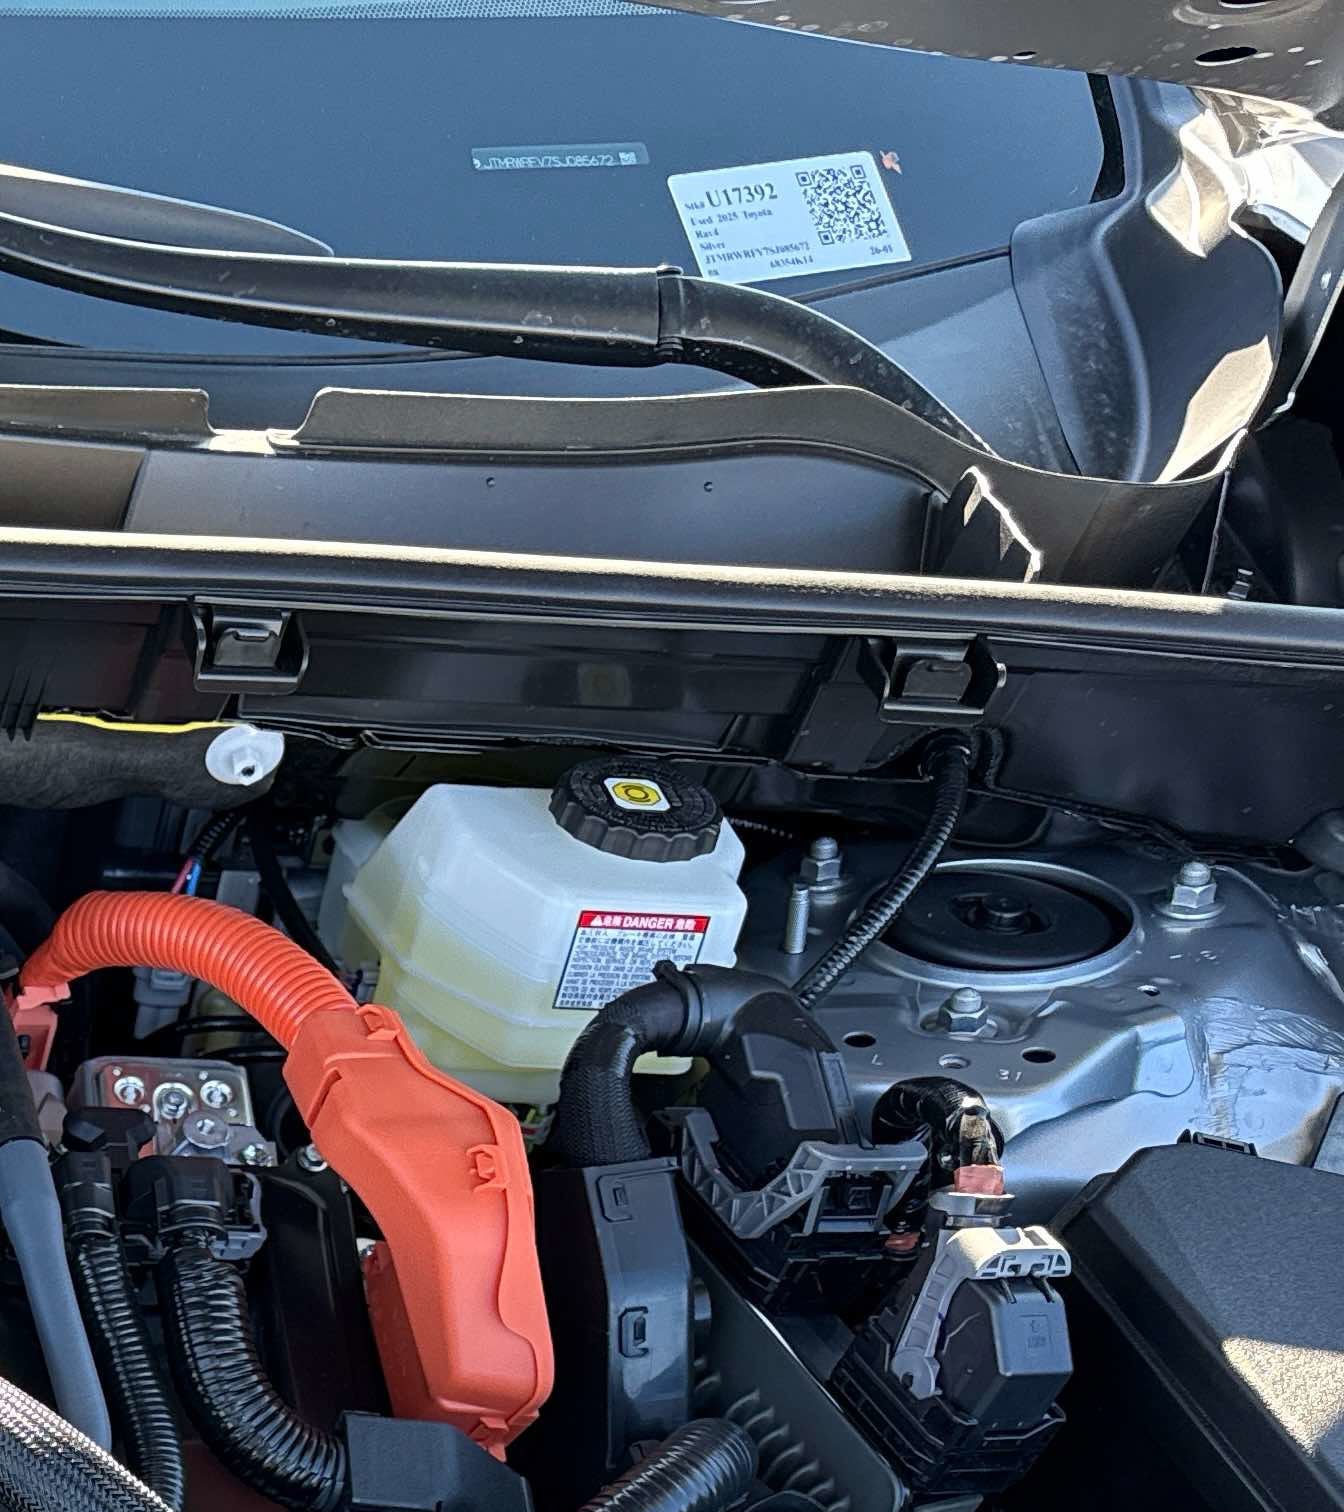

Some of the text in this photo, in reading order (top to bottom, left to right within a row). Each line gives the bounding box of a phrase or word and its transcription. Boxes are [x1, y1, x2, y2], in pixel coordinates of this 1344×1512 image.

[706, 182, 778, 208] U17392
[717, 211, 739, 223] 2025
[743, 208, 773, 221] Toyota
[622, 916, 675, 930] DANGER
